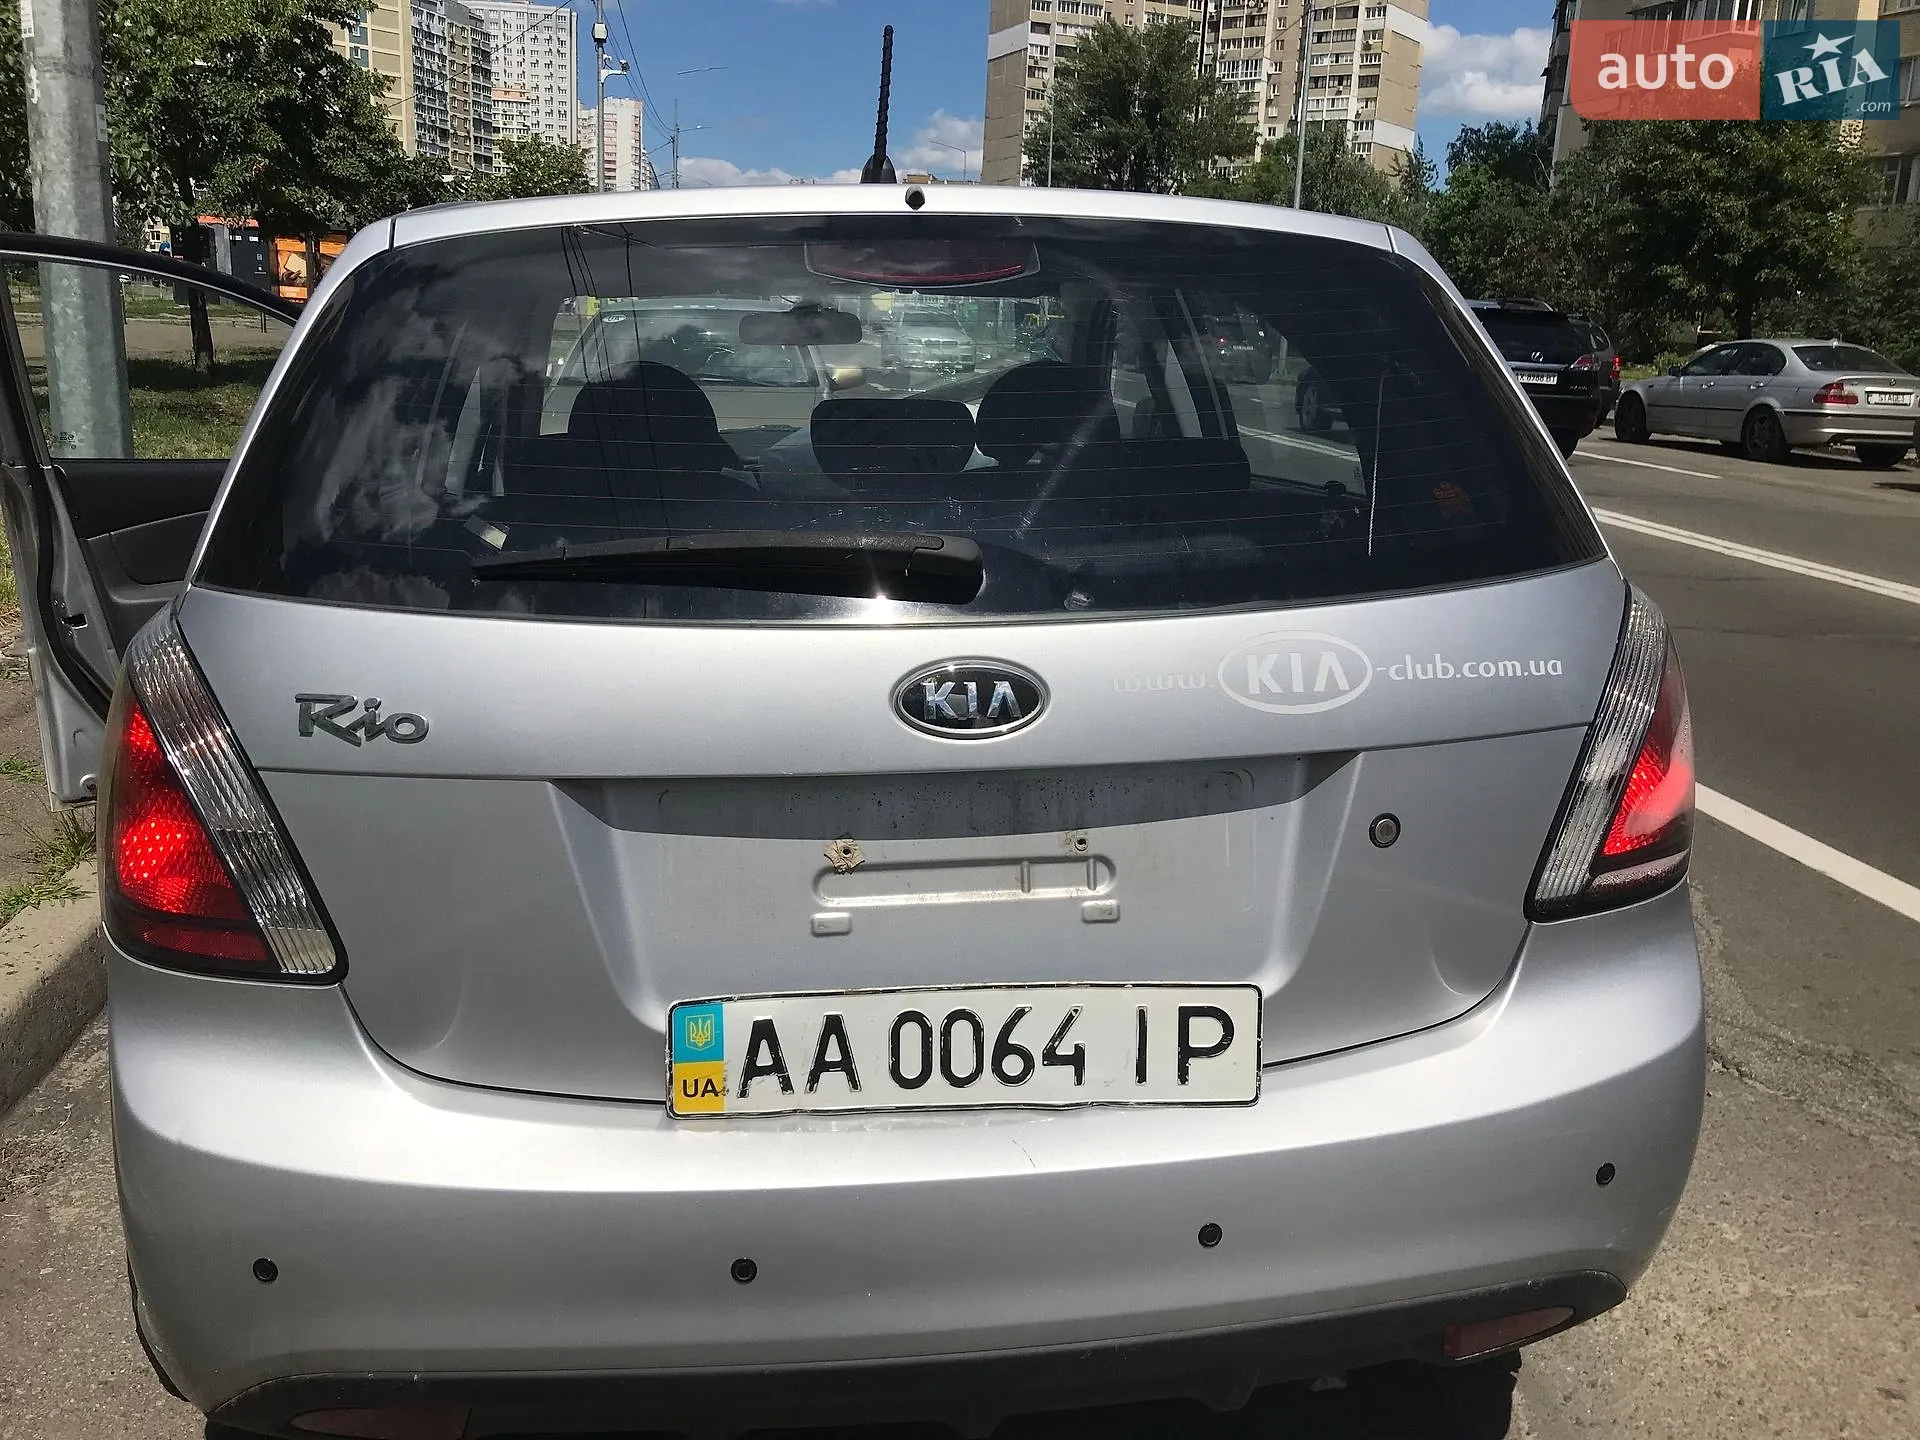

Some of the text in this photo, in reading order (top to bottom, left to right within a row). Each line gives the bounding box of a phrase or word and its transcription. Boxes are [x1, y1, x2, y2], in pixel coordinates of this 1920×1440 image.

[295, 692, 430, 748] Rio
[922, 680, 1023, 720] KIA
[736, 1004, 1235, 1098] AA 0064 IP
[682, 1077, 720, 1099] UA
